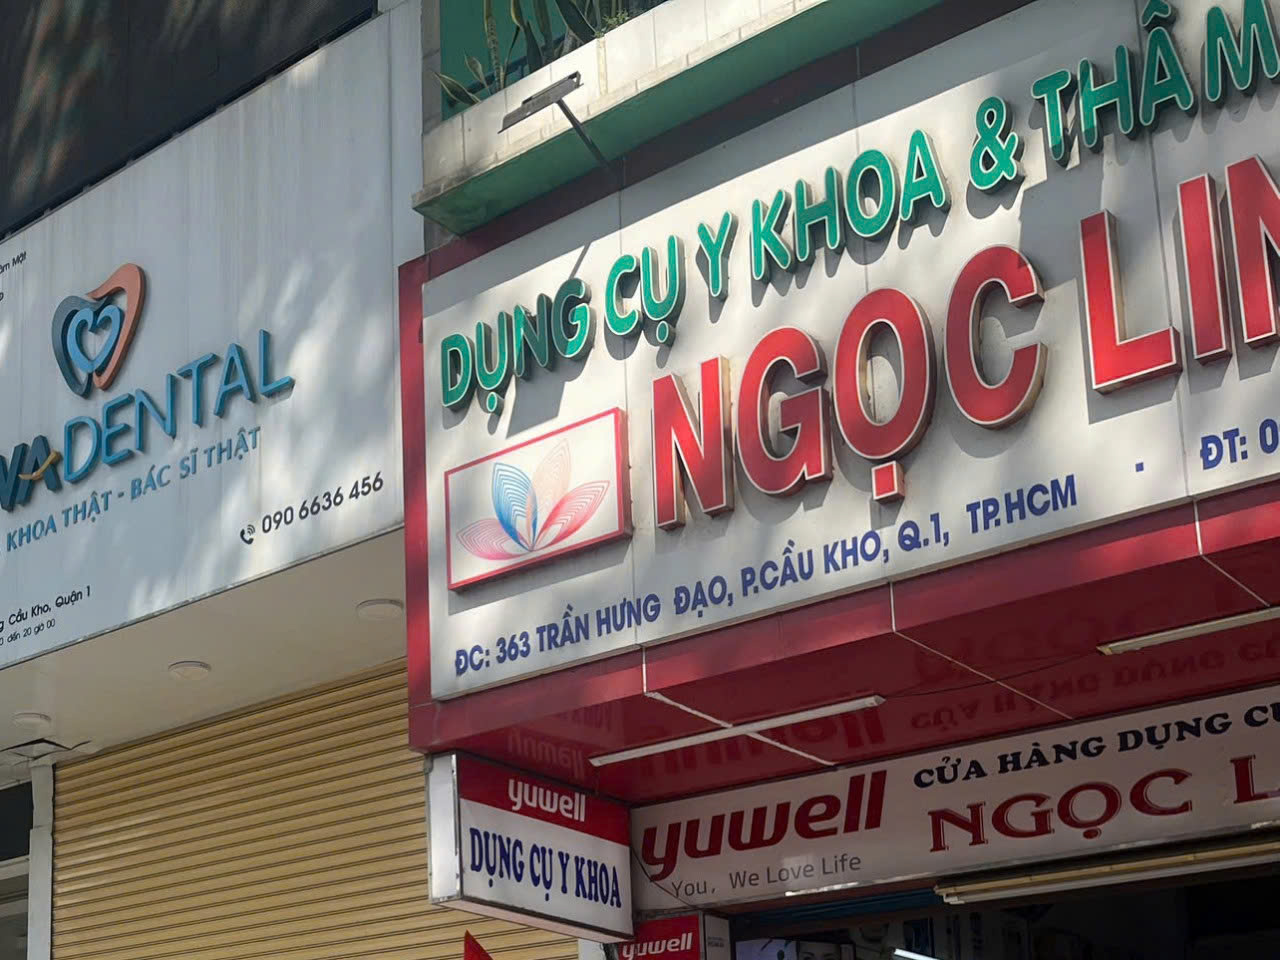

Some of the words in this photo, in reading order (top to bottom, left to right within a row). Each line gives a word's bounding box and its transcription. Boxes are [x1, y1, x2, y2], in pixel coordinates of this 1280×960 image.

[441, 277, 591, 414] DỤNG
[604, 234, 684, 344] CỤ
[697, 212, 737, 297] Y
[750, 128, 947, 282] KHOA
[968, 95, 1023, 193] &
[653, 244, 1046, 529] NGỌC
[7, 519, 58, 553] KHOA
[62, 489, 111, 530] THẬT
[130, 465, 170, 501] BÁC
[179, 440, 200, 478] SĨ
[203, 426, 261, 470] THẬT
[1200, 428, 1248, 470] ĐT:
[261, 506, 294, 534] 090
[299, 490, 344, 521] 6636
[348, 471, 384, 505] 456
[9, 608, 28, 625] Cầu
[31, 602, 51, 618] Kho,
[56, 590, 83, 607] Quận
[86, 585, 91, 597] 1
[455, 647, 491, 675] ĐC:
[496, 631, 531, 666] 363
[536, 605, 590, 655] TRẦN
[596, 592, 662, 638] HƯNG
[673, 574, 735, 618] ĐẠO,
[822, 535, 890, 580] KHO,
[965, 475, 1078, 535] TP.HCM
[914, 756, 988, 789] CỬA
[998, 736, 1107, 775] HÀNG
[1117, 712, 1232, 751] DỤNG
[508, 778, 586, 823] yuwell
[641, 770, 887, 882] yuwell
[928, 768, 1193, 853] NGỌC
[469, 827, 525, 888] DỤNG
[529, 843, 553, 902] CỤ
[558, 851, 570, 894] Y
[574, 855, 621, 909] KHOA
[729, 870, 760, 889] We
[766, 862, 815, 884] Love
[822, 853, 861, 875] Life
